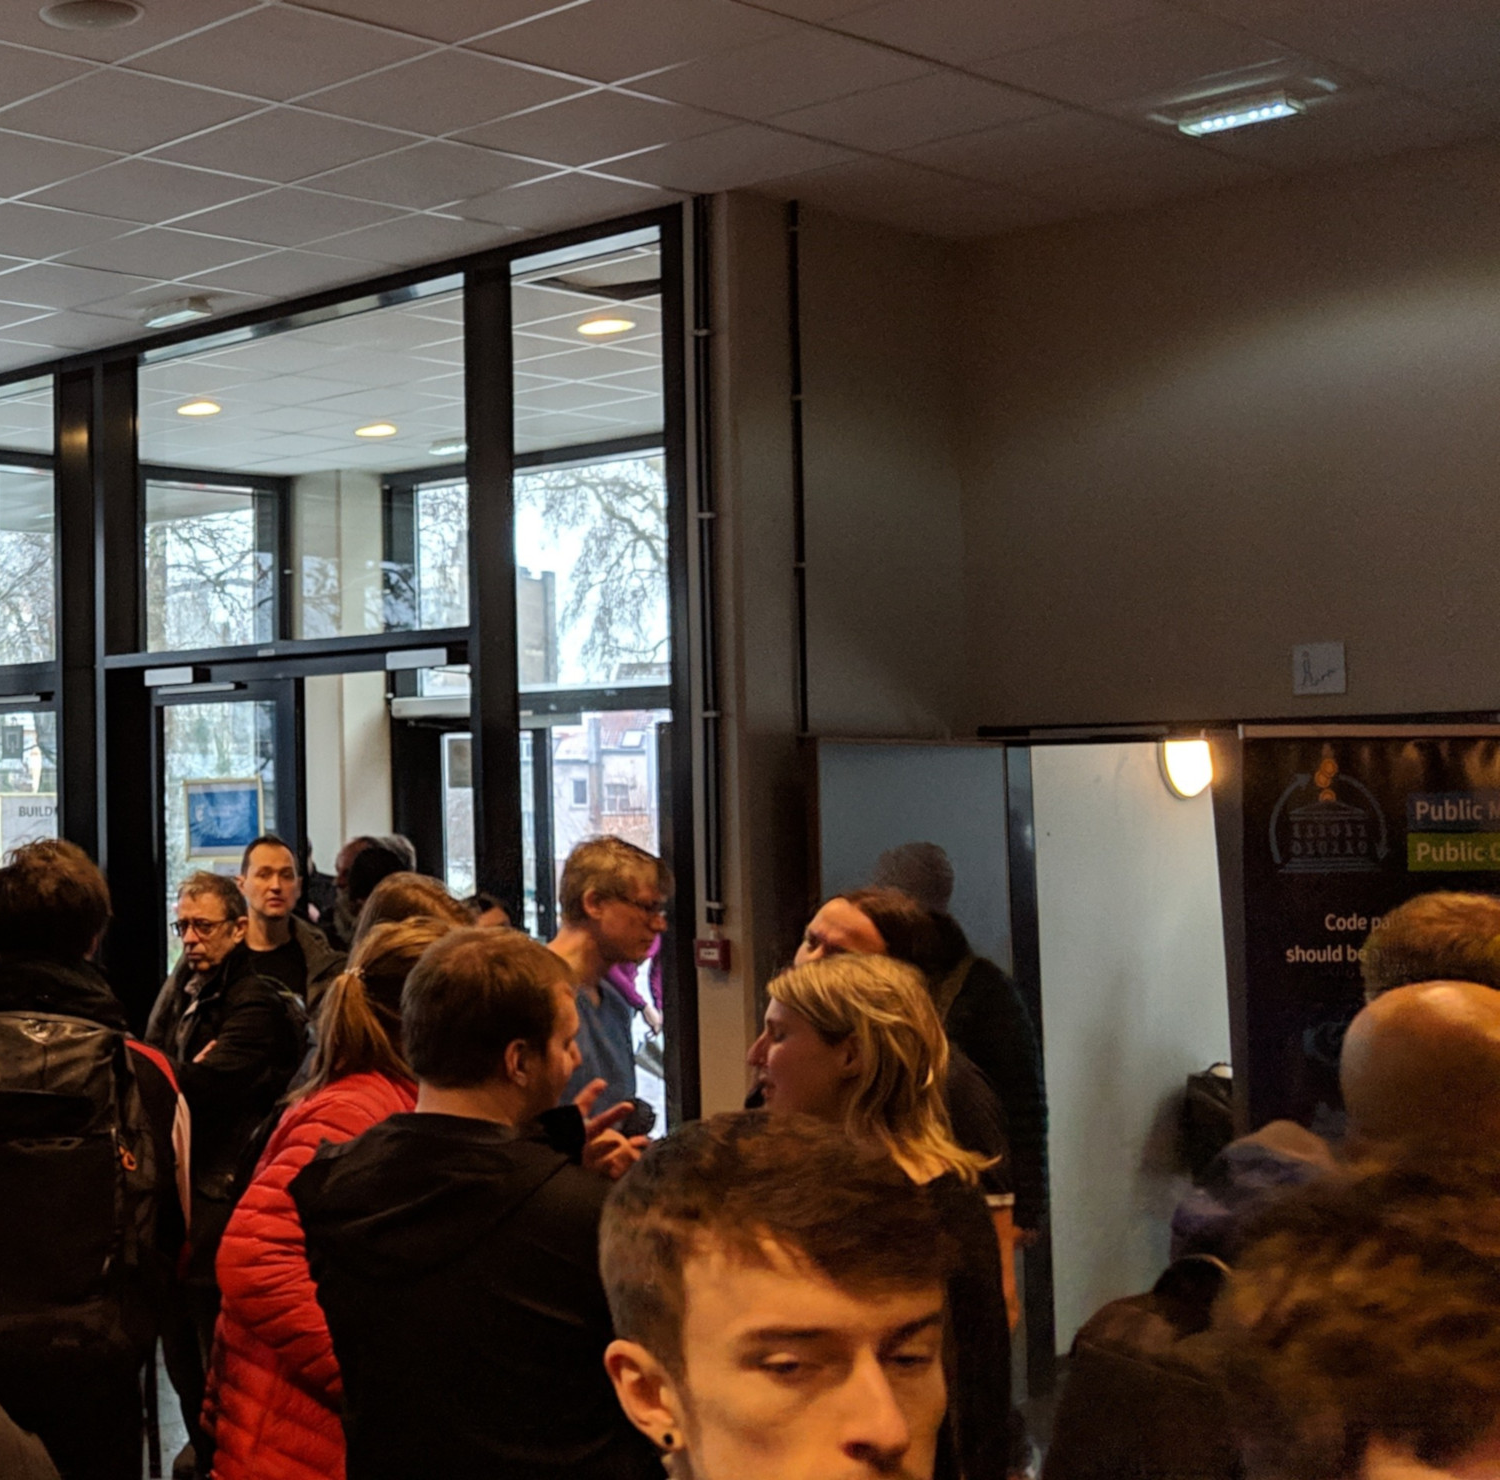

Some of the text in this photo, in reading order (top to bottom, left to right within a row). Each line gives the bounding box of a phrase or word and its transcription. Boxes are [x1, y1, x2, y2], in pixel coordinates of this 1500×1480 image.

[1415, 799, 1484, 821] Public
[1416, 841, 1485, 862] Public
[1324, 912, 1390, 934] Code pa
[1286, 944, 1367, 963] should be
